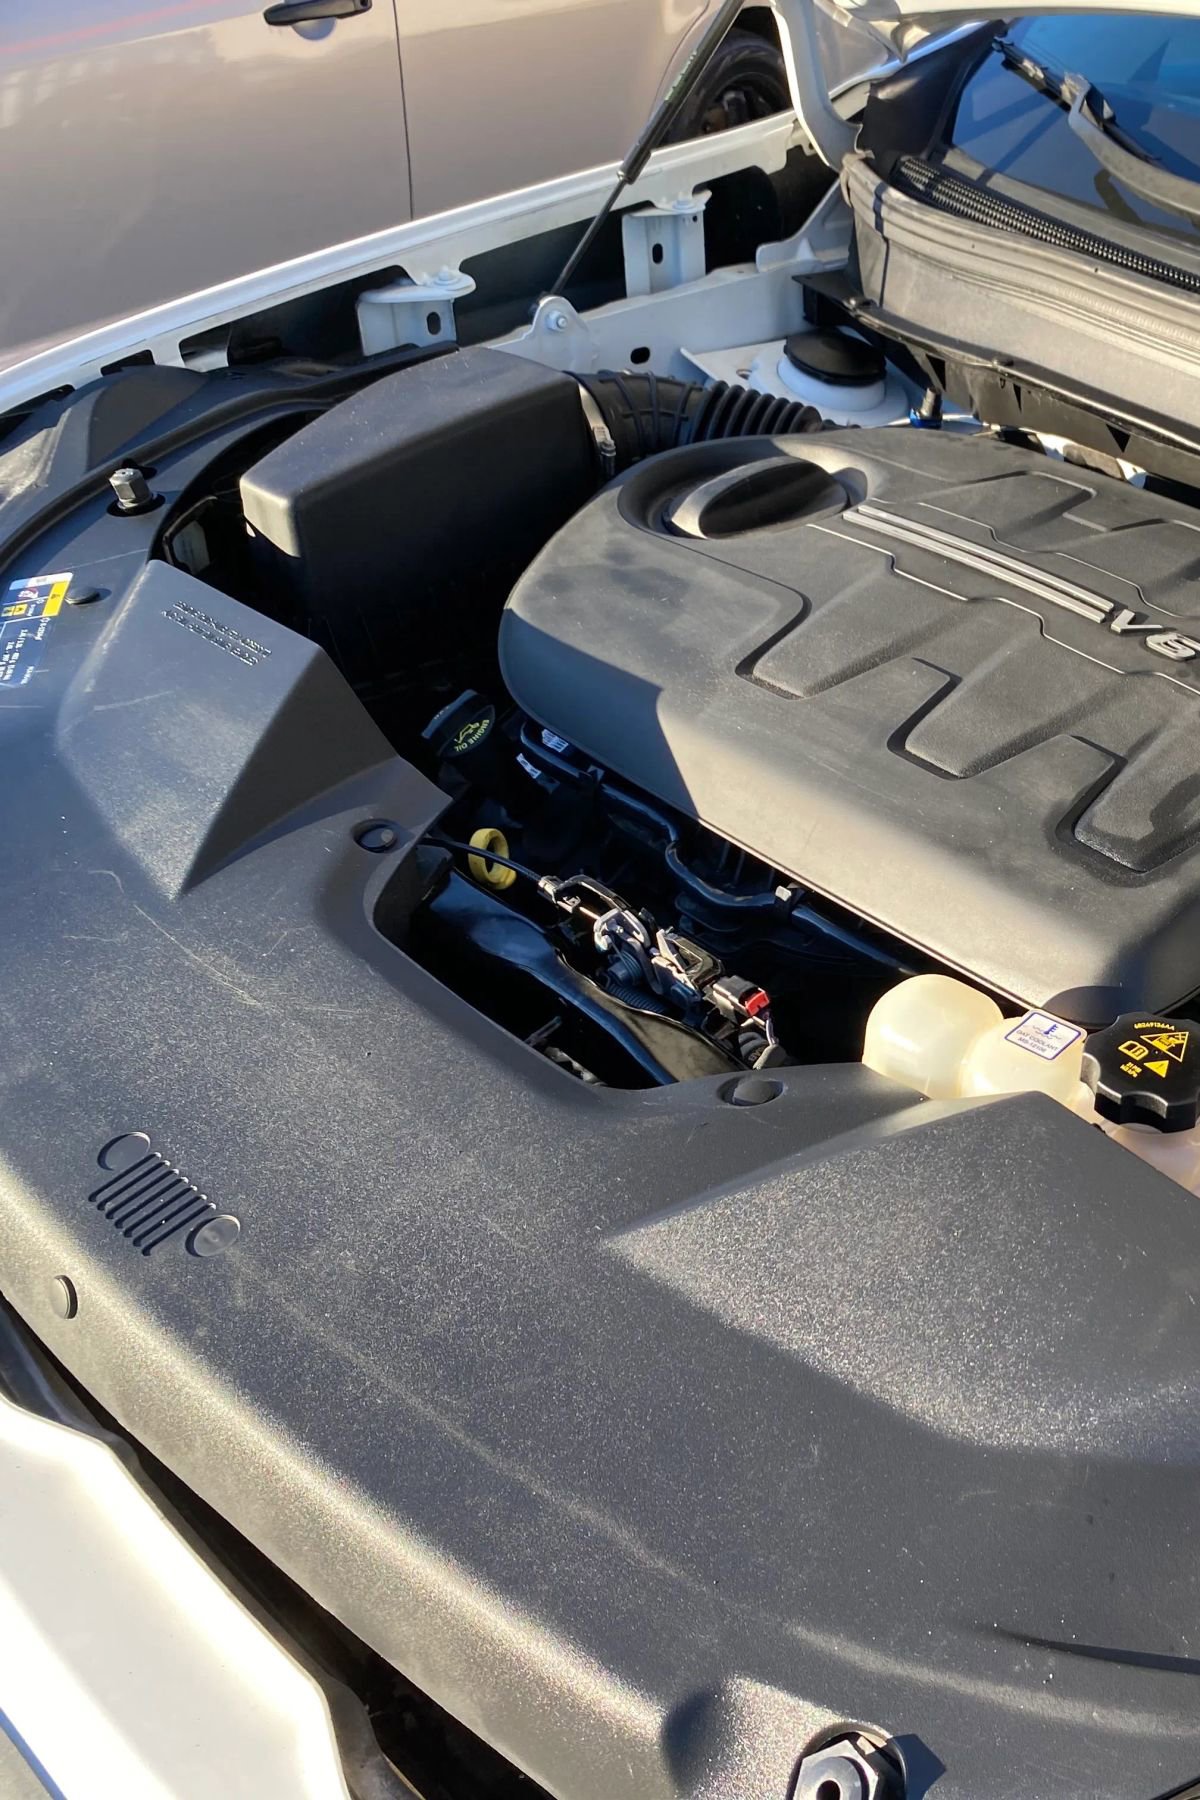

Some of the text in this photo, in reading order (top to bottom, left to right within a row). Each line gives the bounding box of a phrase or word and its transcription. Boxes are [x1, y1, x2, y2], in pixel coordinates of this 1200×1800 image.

[454, 720, 490, 752] ENGINE OIL
[1030, 1036, 1059, 1051] COOLANT
